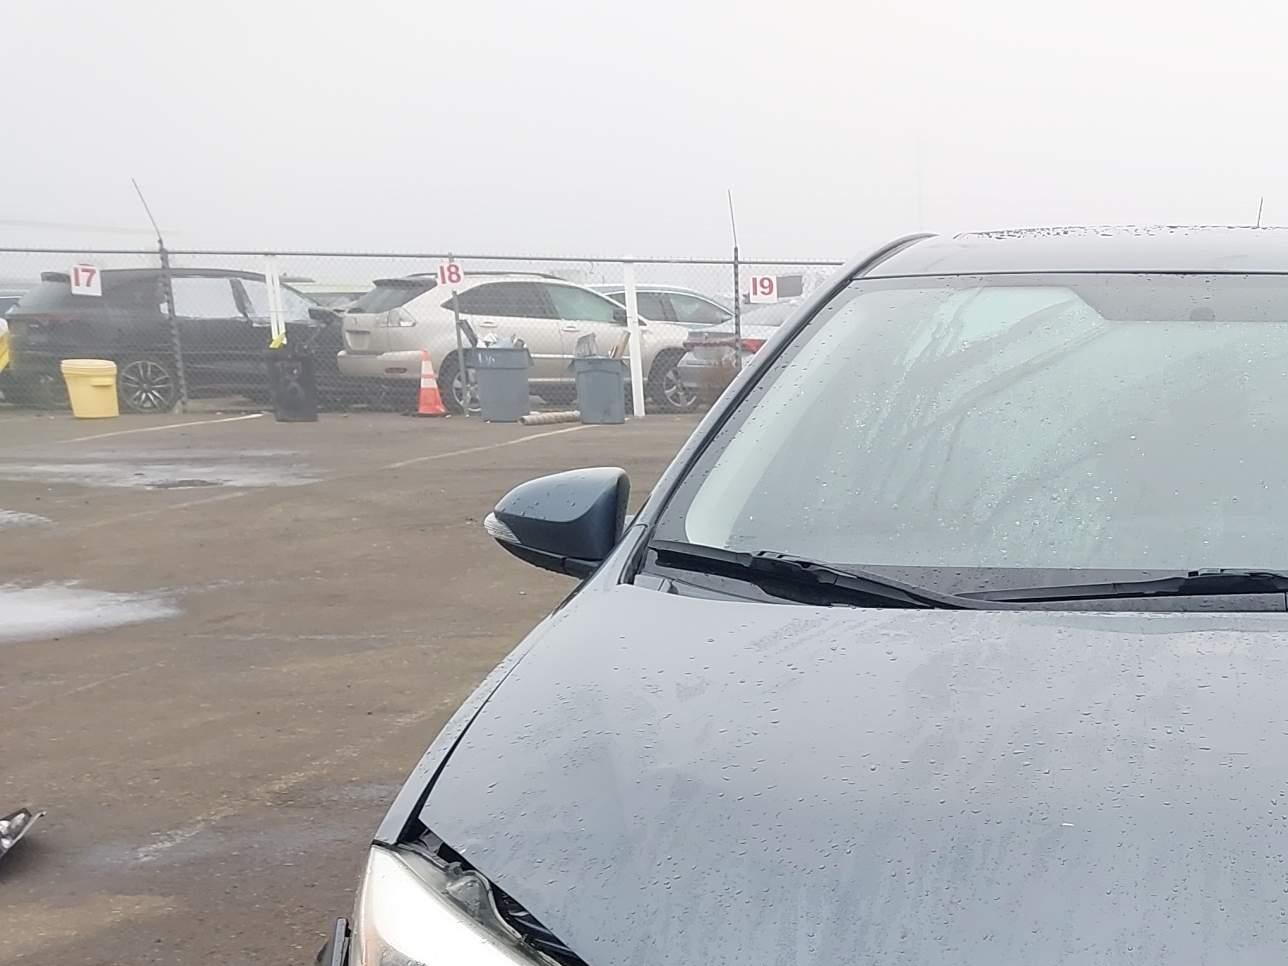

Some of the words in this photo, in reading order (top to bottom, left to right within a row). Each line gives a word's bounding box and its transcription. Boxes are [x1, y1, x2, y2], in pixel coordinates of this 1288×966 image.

[73, 267, 97, 287] 17
[440, 264, 461, 284] 18
[752, 277, 774, 296] 19
